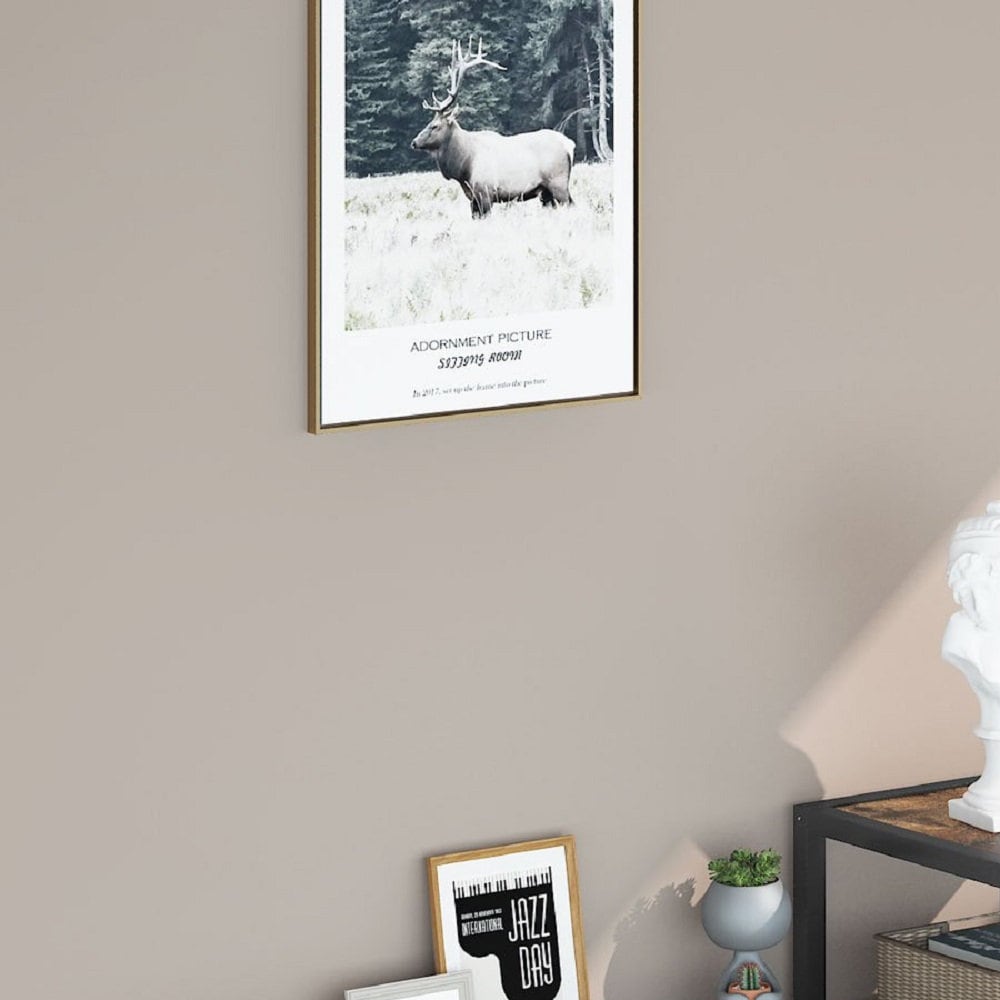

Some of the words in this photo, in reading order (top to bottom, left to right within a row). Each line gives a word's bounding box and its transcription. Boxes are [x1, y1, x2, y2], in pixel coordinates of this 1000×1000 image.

[410, 334, 494, 352] ADORNMENT
[498, 329, 552, 343] PICTURE
[437, 353, 485, 369] SITTING
[488, 350, 522, 363] ROOM
[461, 917, 504, 937] INTERNATIONAL
[508, 893, 550, 942] JAZZ
[519, 942, 554, 990] DAY
